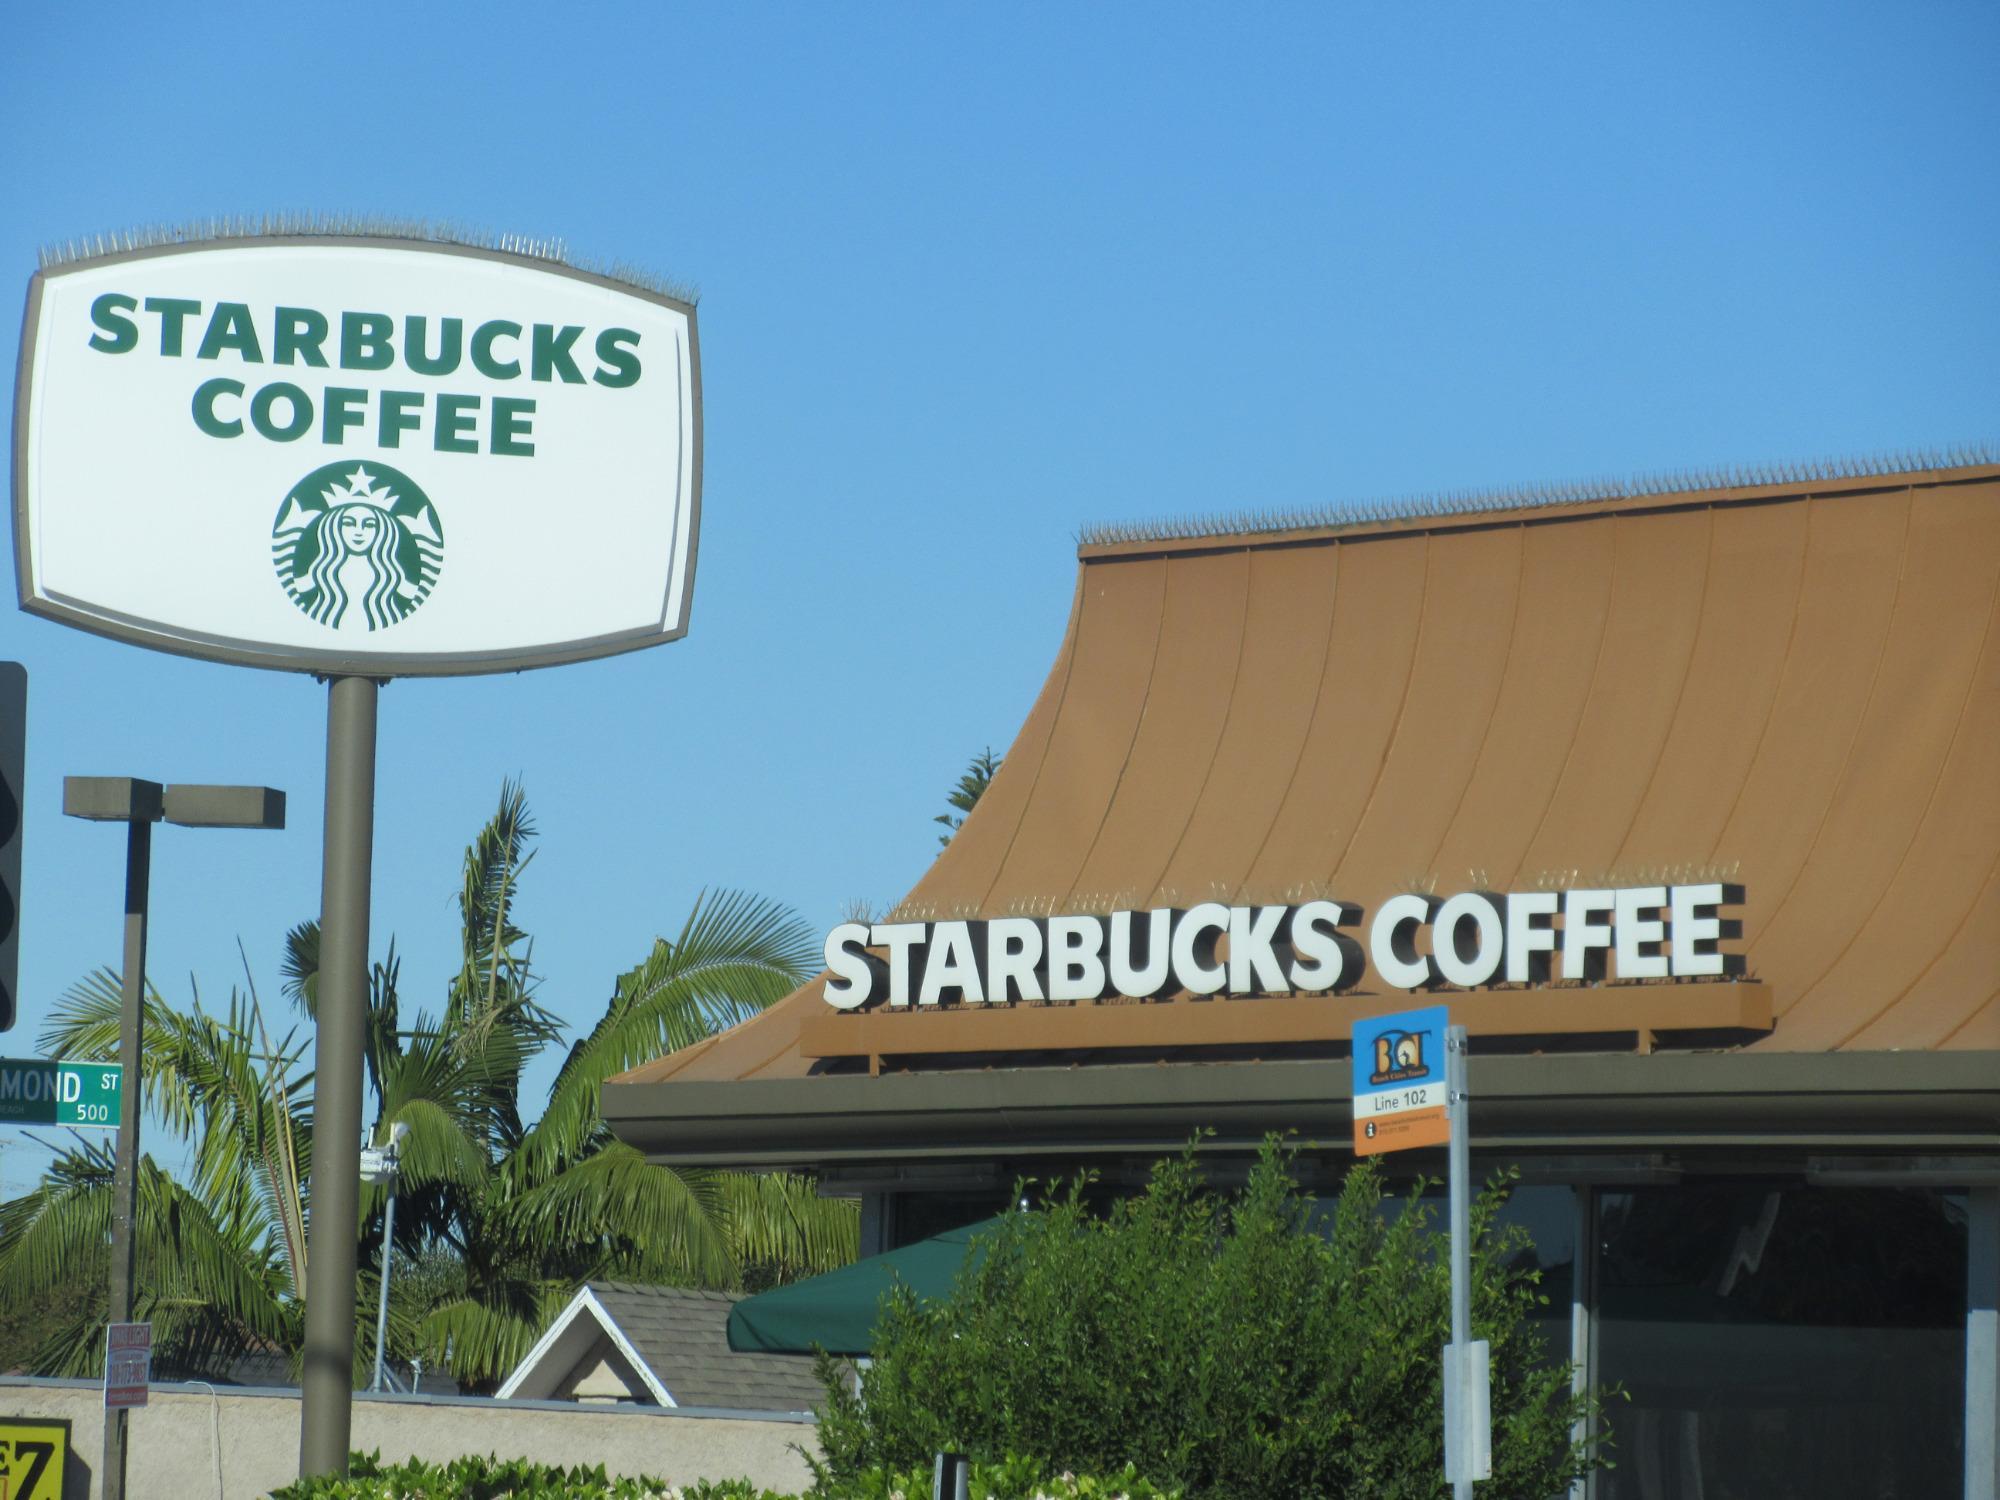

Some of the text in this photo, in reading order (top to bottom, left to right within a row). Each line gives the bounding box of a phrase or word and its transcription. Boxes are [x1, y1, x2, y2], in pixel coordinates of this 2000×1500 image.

[88, 293, 642, 389] STARBUCKS
[191, 377, 537, 457] COFFEE
[821, 883, 1725, 1011] STARBUCKS COFFEE
[101, 1074, 118, 1090] ST
[1375, 1089, 1427, 1111] Line 102
[77, 1104, 108, 1121] 500
